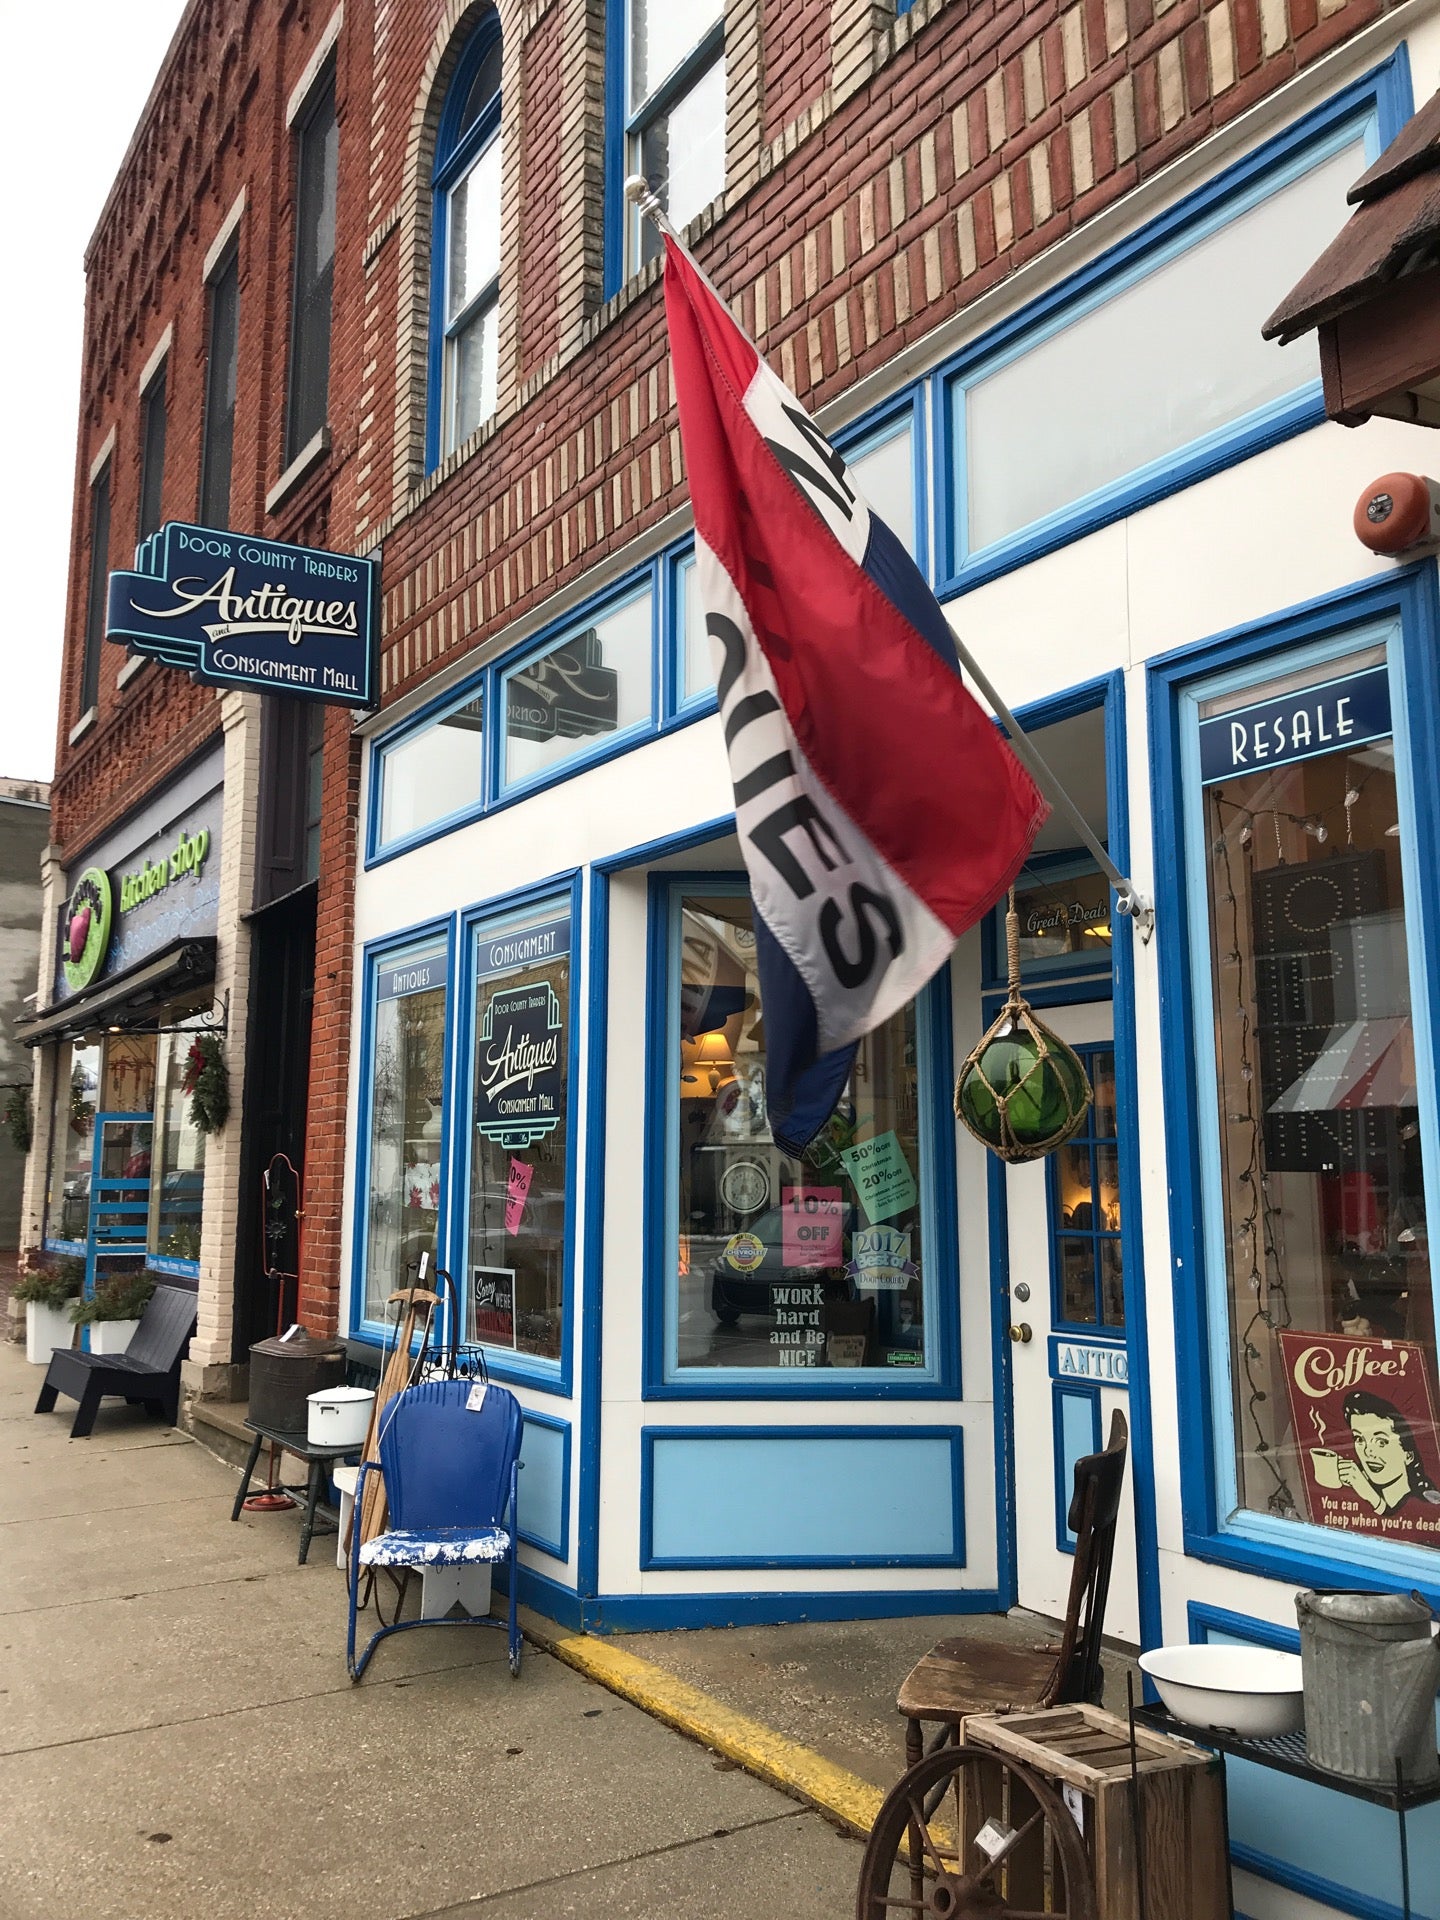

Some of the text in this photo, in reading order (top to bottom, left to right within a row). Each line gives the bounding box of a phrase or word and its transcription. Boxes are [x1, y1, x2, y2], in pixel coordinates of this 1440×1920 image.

[179, 531, 358, 583] DOOR COUNTY TRADERS
[130, 566, 358, 645] Antiques
[211, 624, 231, 638] and
[213, 649, 359, 692] CONSIGNMENT MALL
[1230, 697, 1354, 766] RESALE
[169, 829, 209, 882] shop
[1027, 899, 1108, 932] Great Deals
[489, 930, 556, 967] CONSIGNMENT
[392, 967, 430, 994] ANTIQUES
[494, 995, 546, 1015] DOOR COUNTY TRADERS
[481, 1024, 558, 1092] Antiques
[497, 1093, 555, 1115] CONSIGNMENT MALL
[851, 1142, 881, 1163] 50%
[862, 1168, 893, 1190] 20%
[788, 1194, 839, 1215] 10%
[797, 1225, 830, 1241] OFF
[855, 1231, 907, 1255] 2017
[776, 1308, 820, 1325] hard
[769, 1329, 826, 1344] and Be
[778, 1349, 816, 1367] NICE
[1294, 1346, 1409, 1398] Coffee!
[1321, 1496, 1359, 1511] You can
[1324, 1514, 1440, 1532] sleep when you're dead
